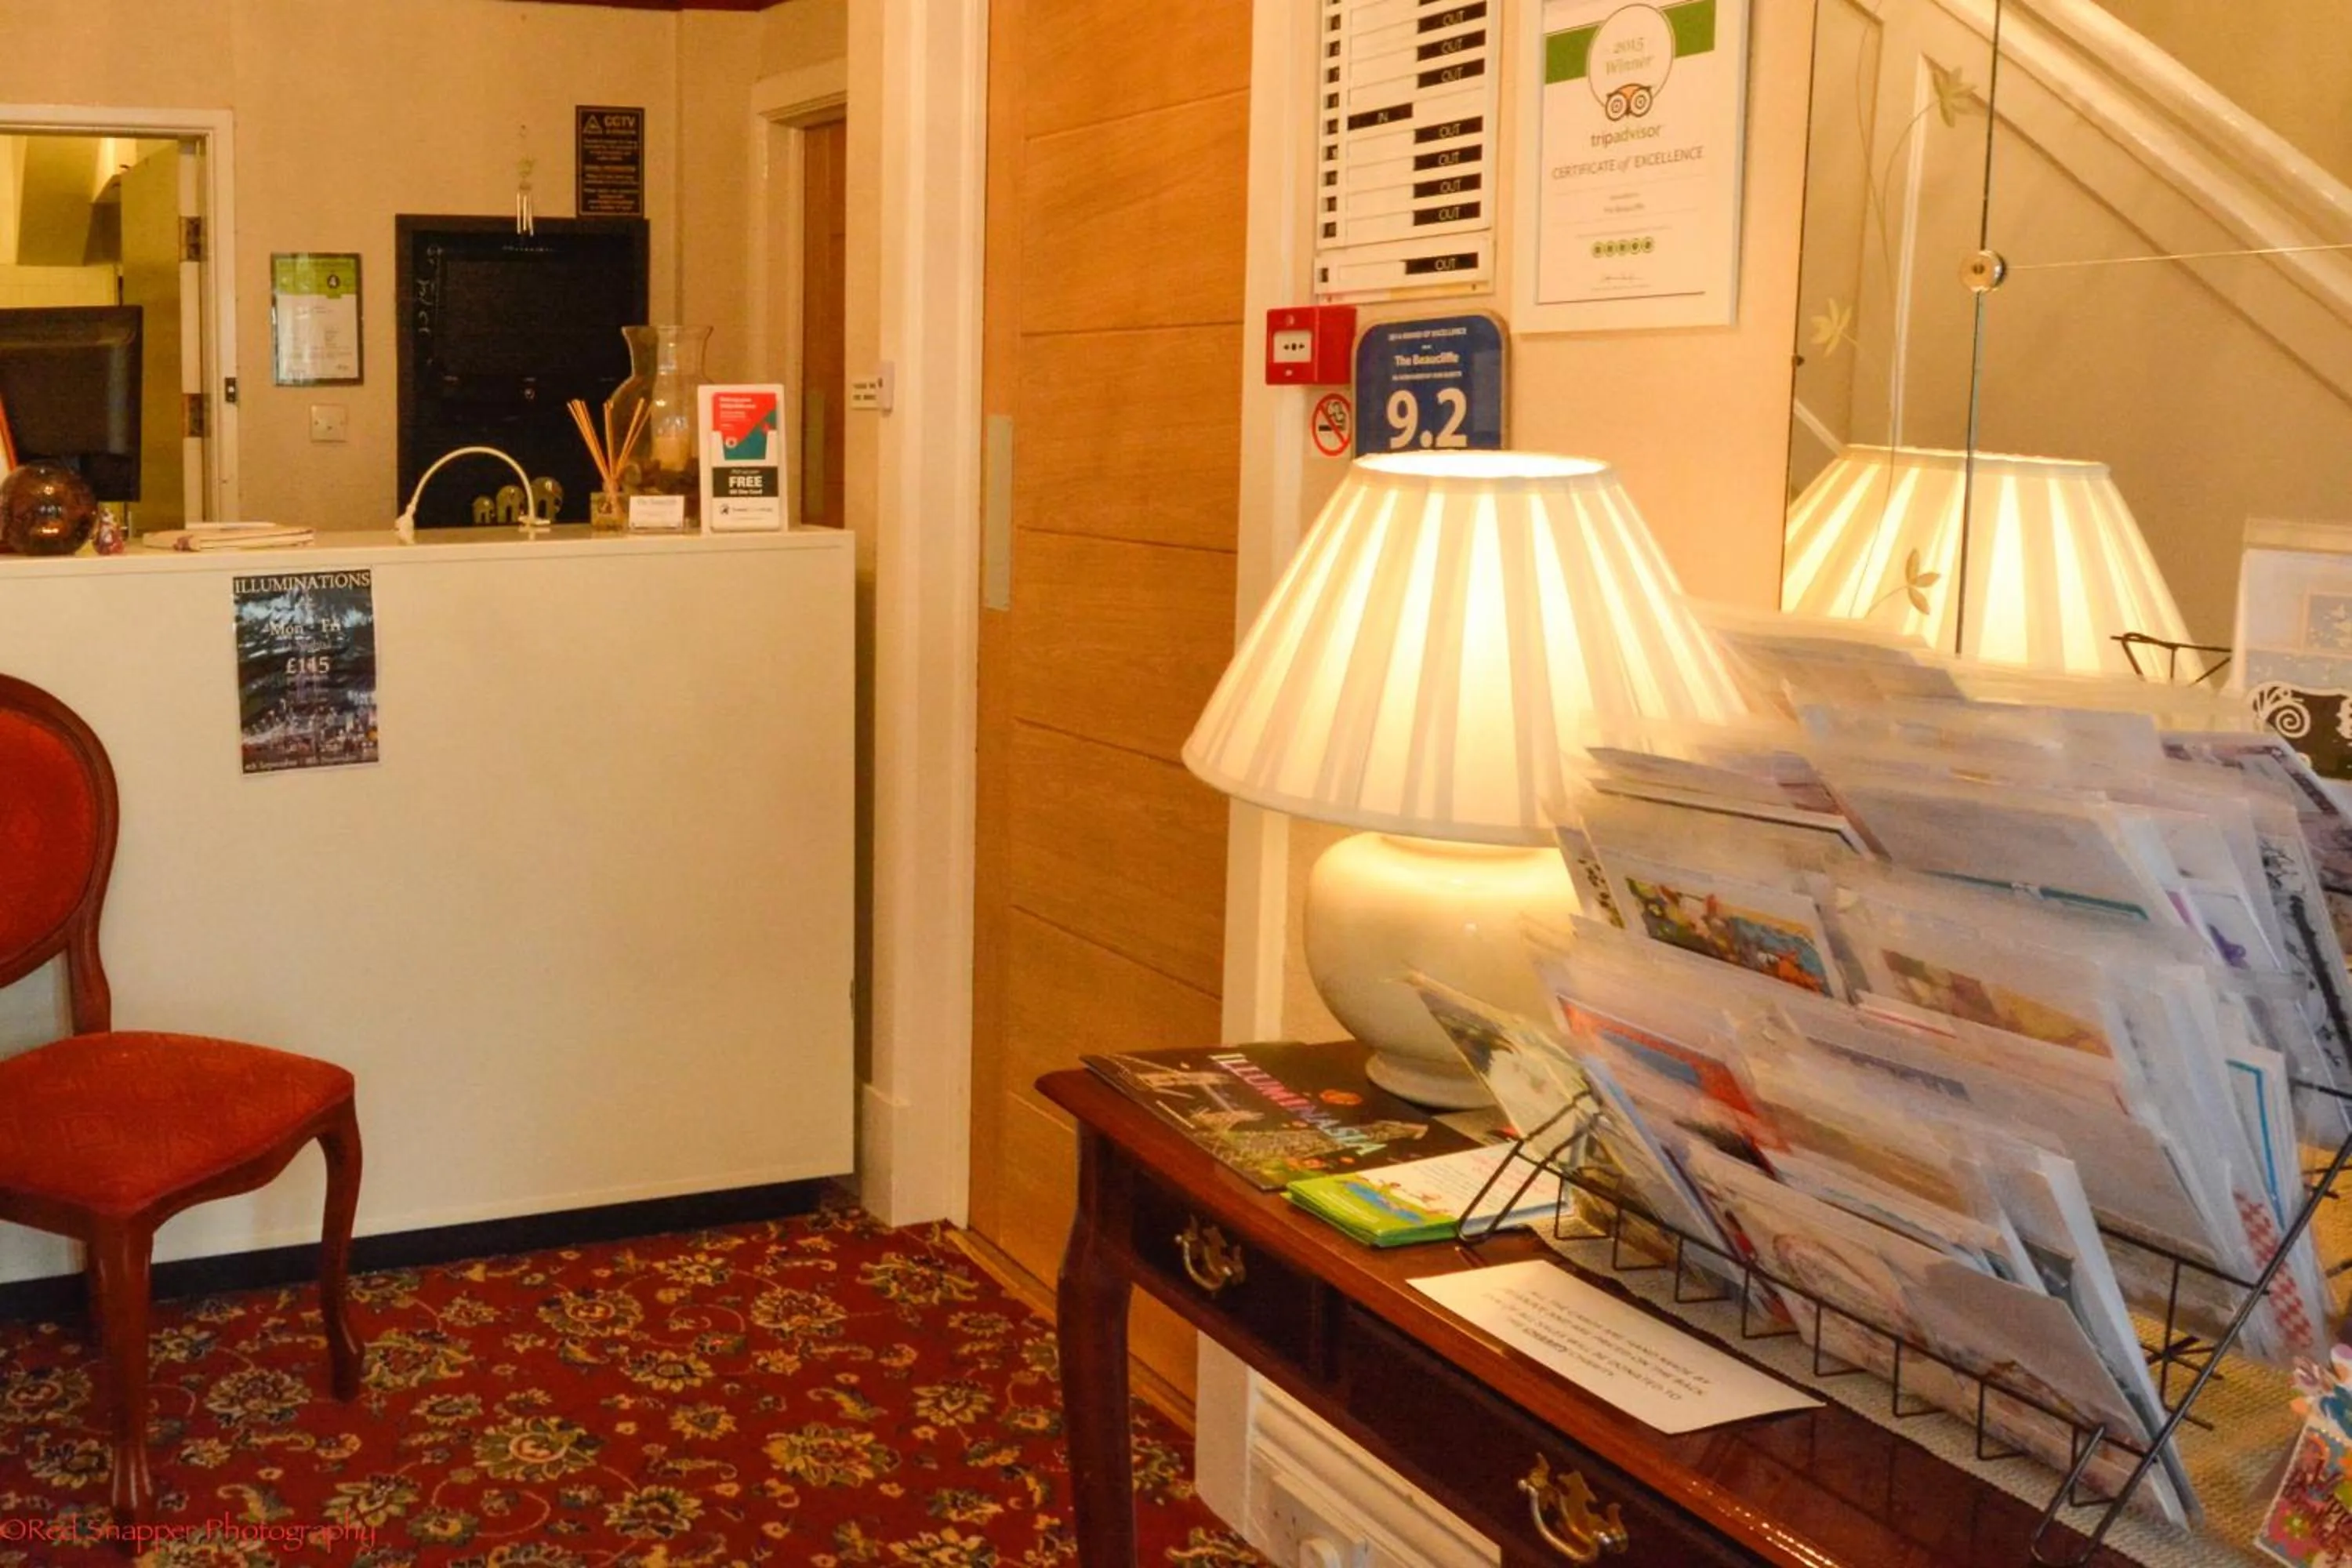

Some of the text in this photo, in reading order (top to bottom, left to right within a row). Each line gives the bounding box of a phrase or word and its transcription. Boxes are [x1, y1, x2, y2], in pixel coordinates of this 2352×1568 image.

[1443, 11, 1465, 27] OUT
[1442, 38, 1463, 54] OUT
[1613, 38, 1644, 53] 2015
[1606, 56, 1654, 75] Winner
[1441, 67, 1463, 82] OUT
[604, 115, 636, 127] CCTV
[1377, 112, 1388, 122] IN
[1439, 124, 1461, 138] OUT
[1591, 125, 1661, 148] tripadvisor
[1438, 151, 1460, 165] OUT
[1552, 146, 1704, 180] CERTIFICATE of EXCELLENCE
[1440, 180, 1461, 194] OUT
[1439, 207, 1460, 220] OUT
[1435, 258, 1456, 271] OUT
[1395, 354, 1412, 367] The
[1387, 387, 1468, 449] 9.2
[729, 476, 763, 488] FREE
[235, 572, 370, 593] ILLUMINATIONS
[270, 621, 303, 636] Mon
